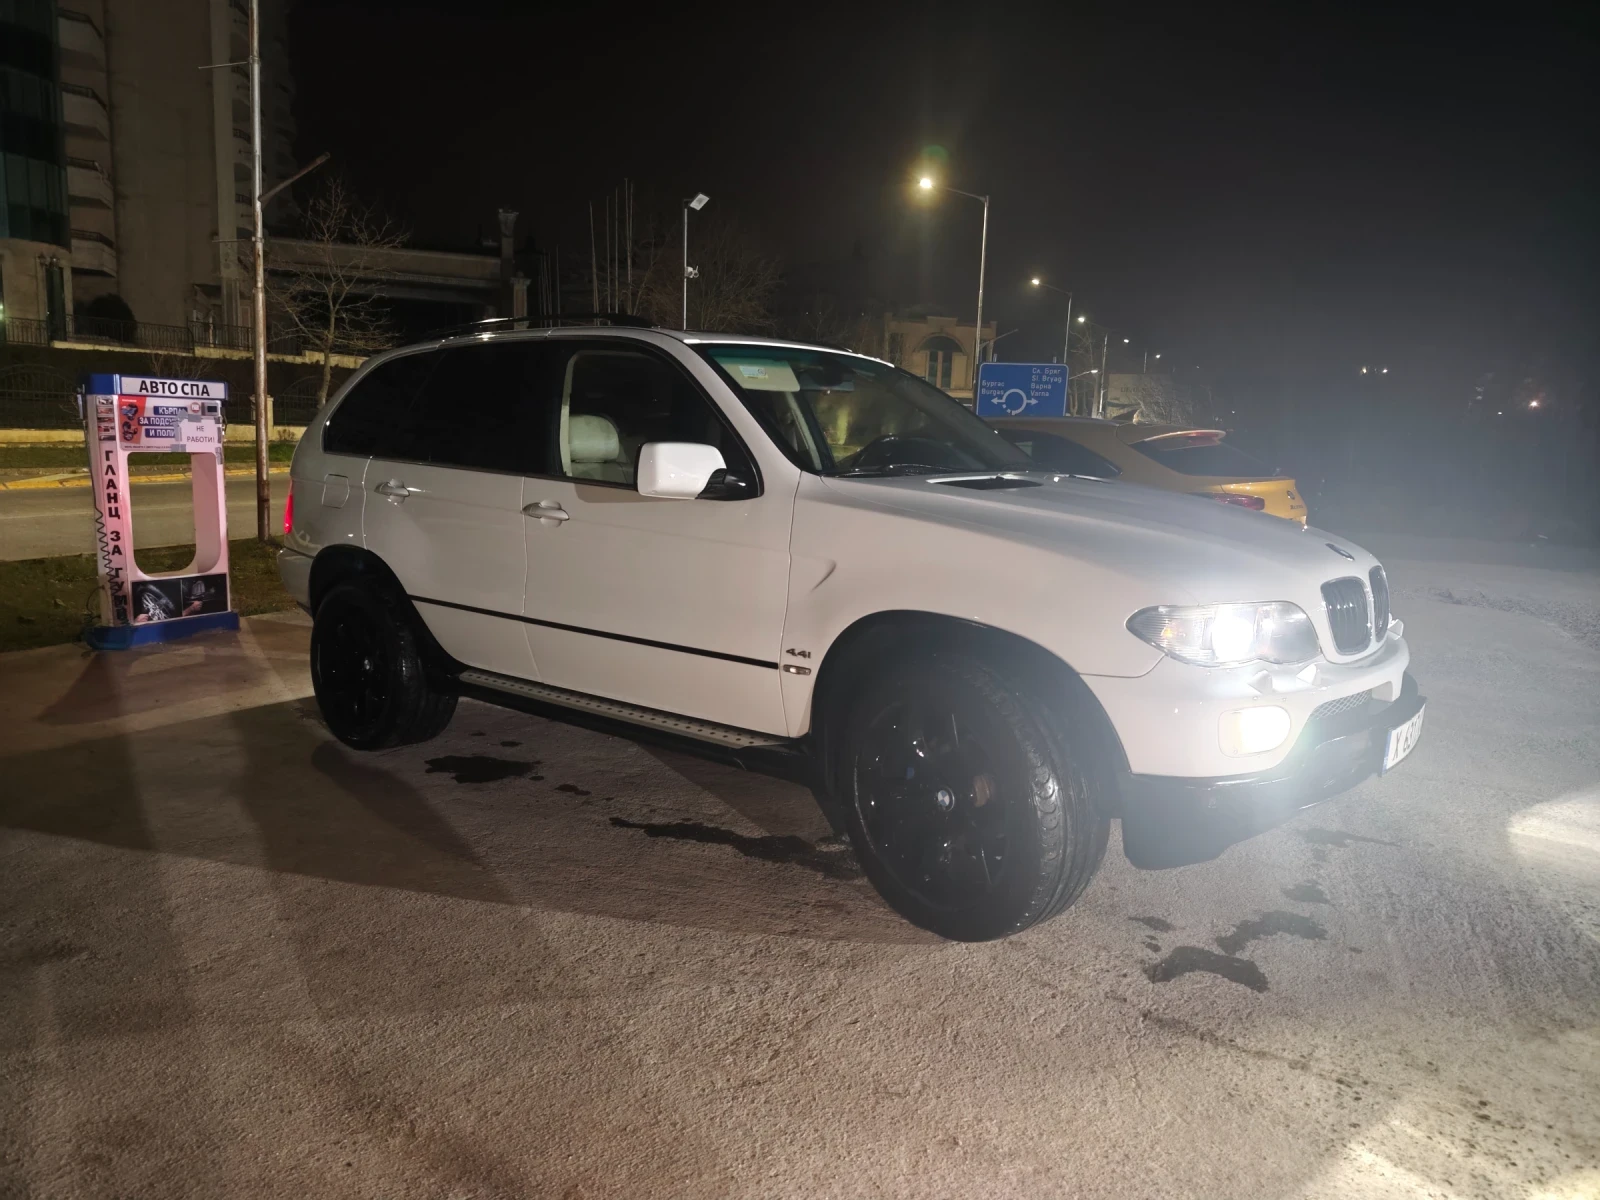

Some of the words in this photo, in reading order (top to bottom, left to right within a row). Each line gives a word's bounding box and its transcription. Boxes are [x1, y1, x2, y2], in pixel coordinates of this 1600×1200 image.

[1044, 367, 1061, 375] Бряг
[1042, 375, 1062, 383] Bryag
[981, 380, 1005, 388] Бургас
[139, 380, 178, 394] АВТО
[181, 383, 210, 397] СПА
[981, 388, 1004, 396] Burgas
[139, 417, 149, 425] ЗА
[149, 429, 155, 437] И
[105, 451, 120, 520] ГЛАНЦ
[110, 531, 123, 556] ЗА
